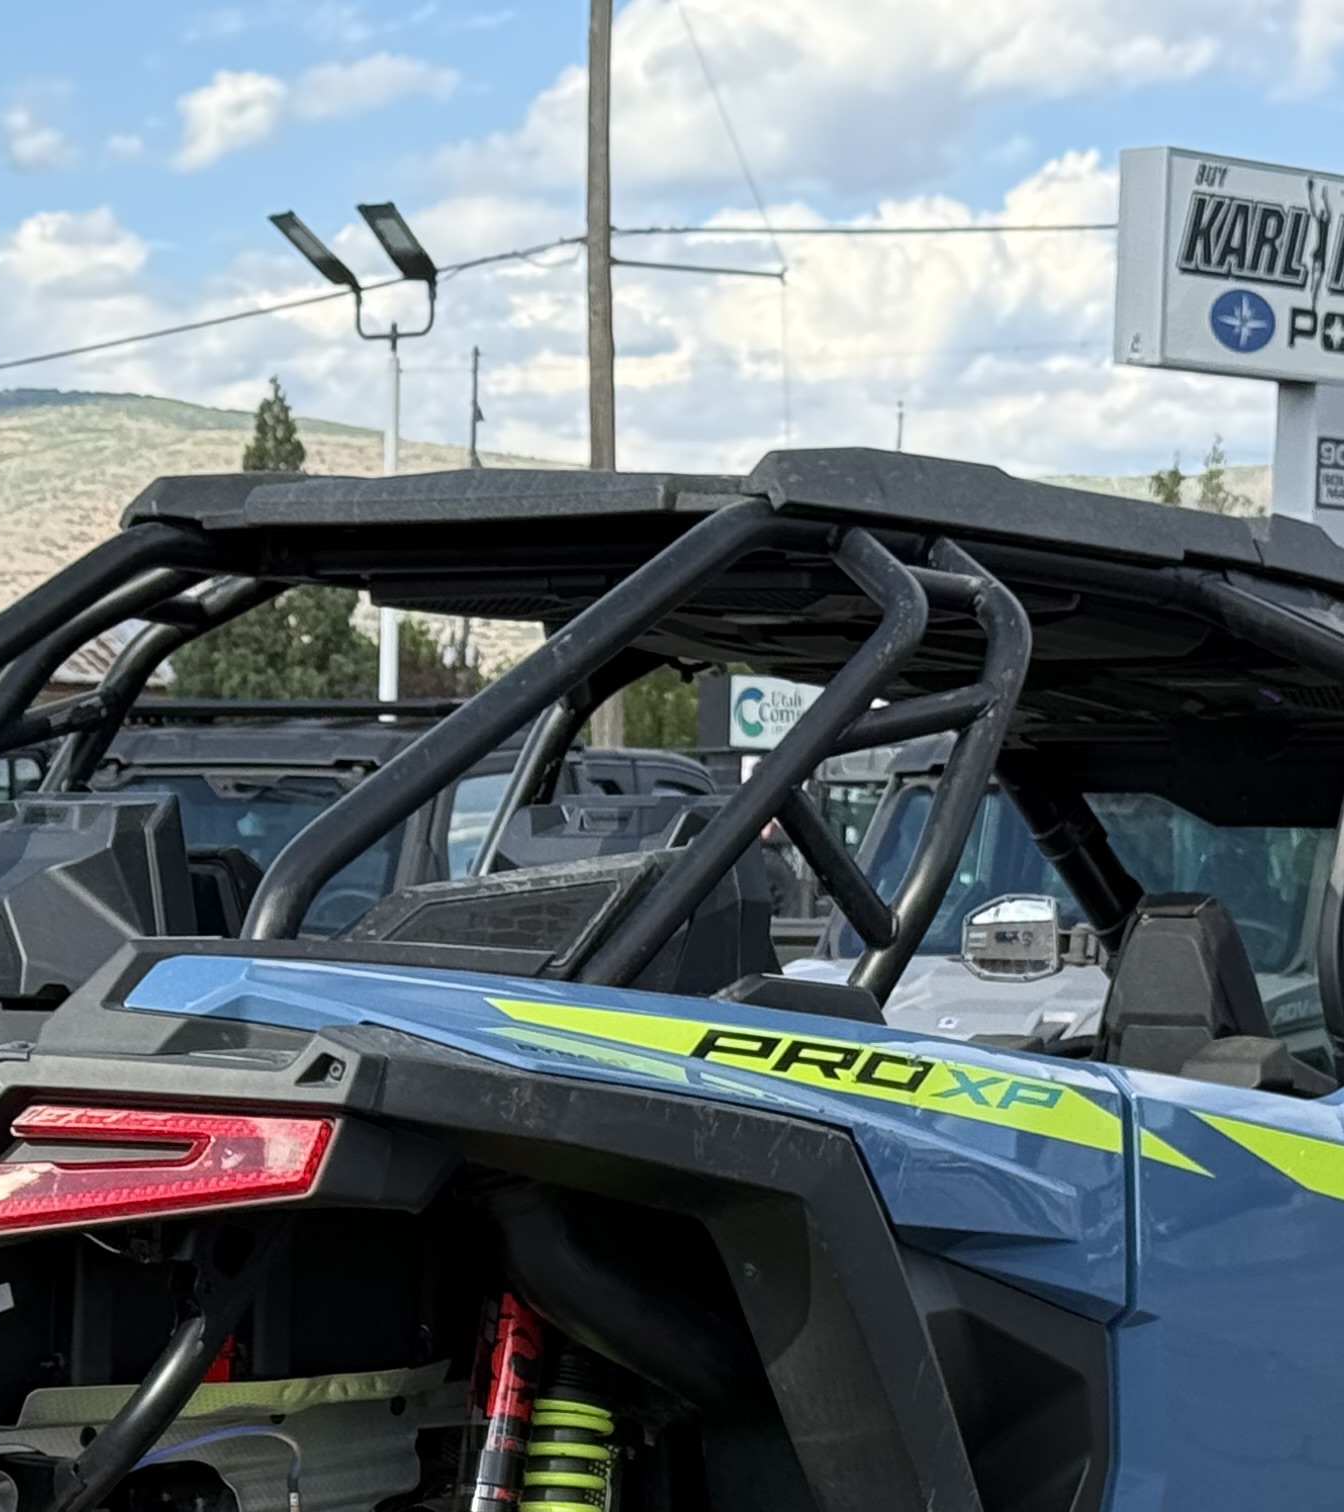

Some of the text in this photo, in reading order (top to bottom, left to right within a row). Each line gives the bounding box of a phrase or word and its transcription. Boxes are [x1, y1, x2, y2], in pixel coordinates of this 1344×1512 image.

[1195, 163, 1227, 187] BUY
[1179, 191, 1310, 289] KARL
[771, 688, 803, 708] Utah
[691, 1028, 935, 1093] PRO
[930, 1068, 1063, 1109] XP
